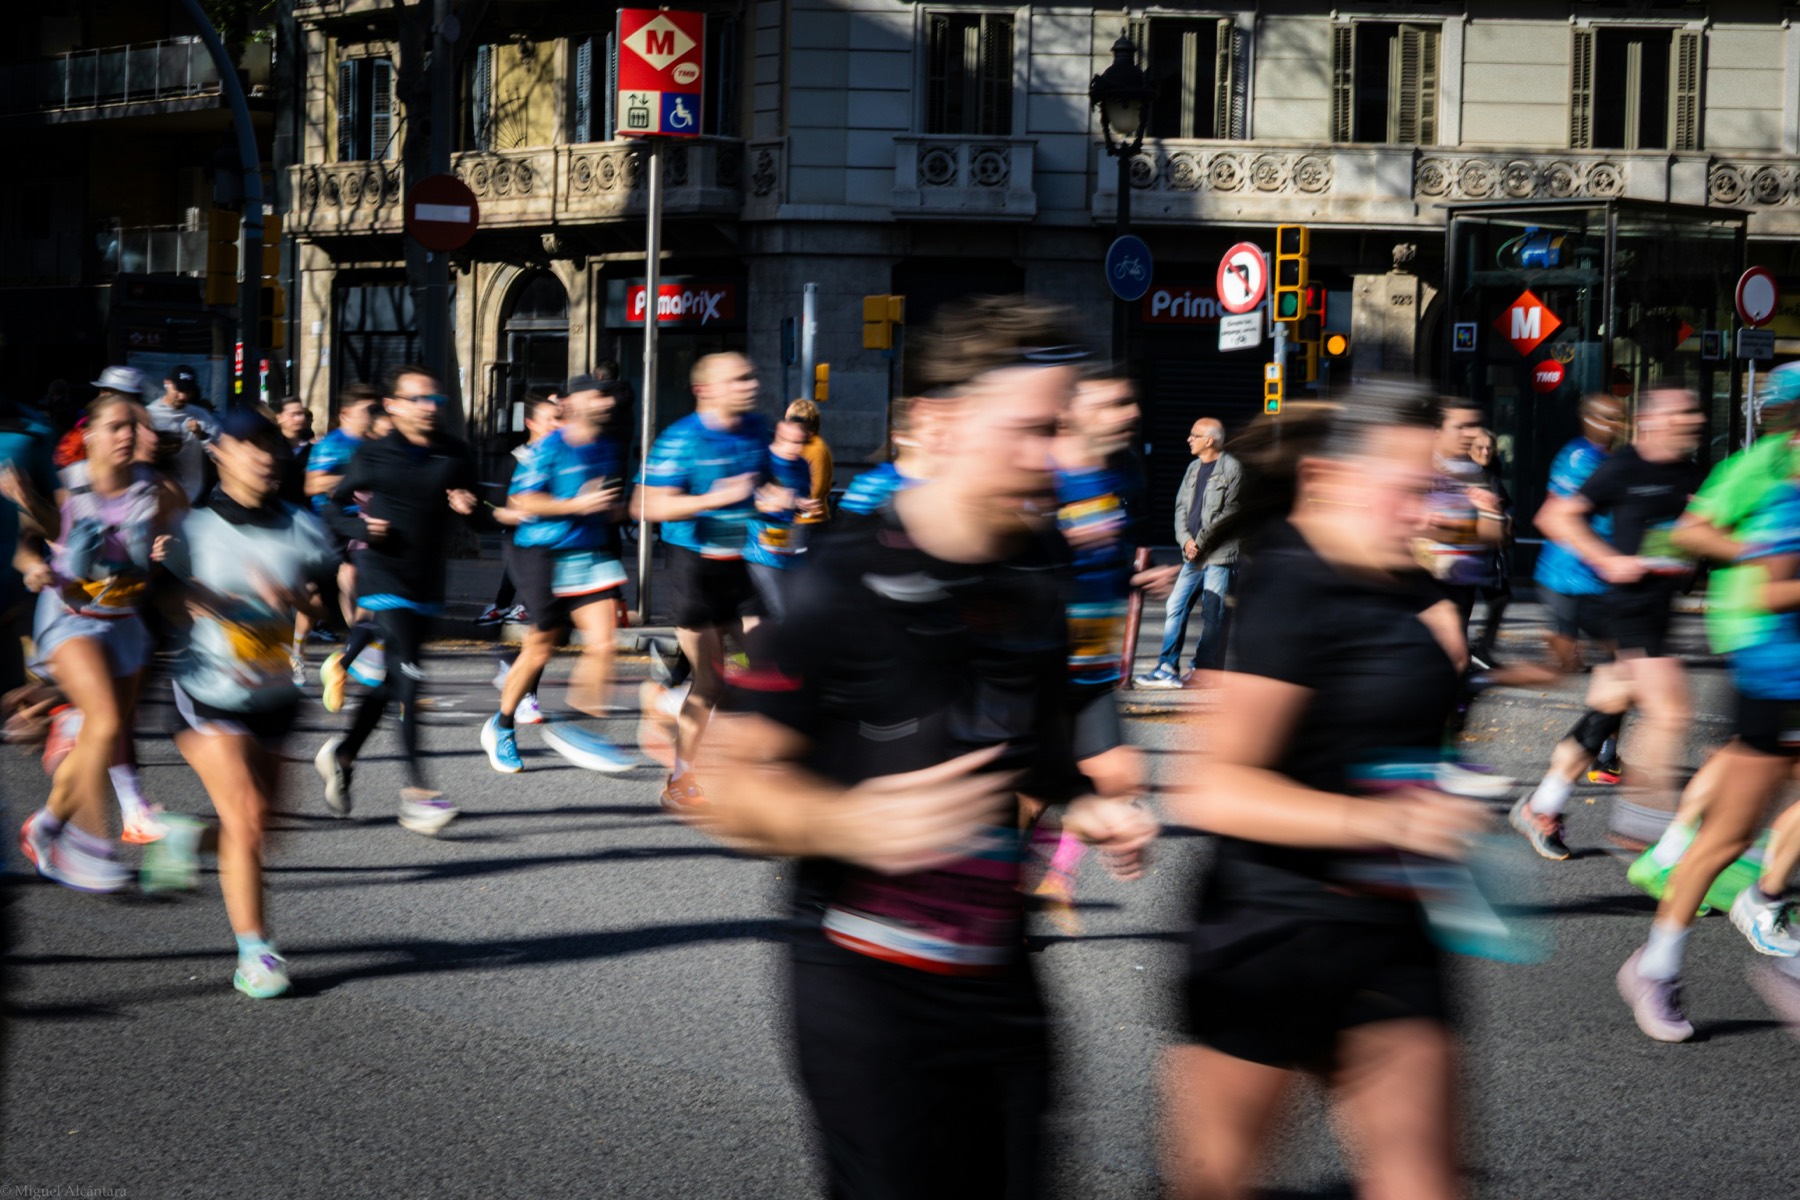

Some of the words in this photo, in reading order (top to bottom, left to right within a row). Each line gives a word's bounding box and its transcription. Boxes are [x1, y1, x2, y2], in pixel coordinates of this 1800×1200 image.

[645, 30, 675, 55] M
[1511, 307, 1542, 339] M
[1535, 370, 1562, 383] TMB
